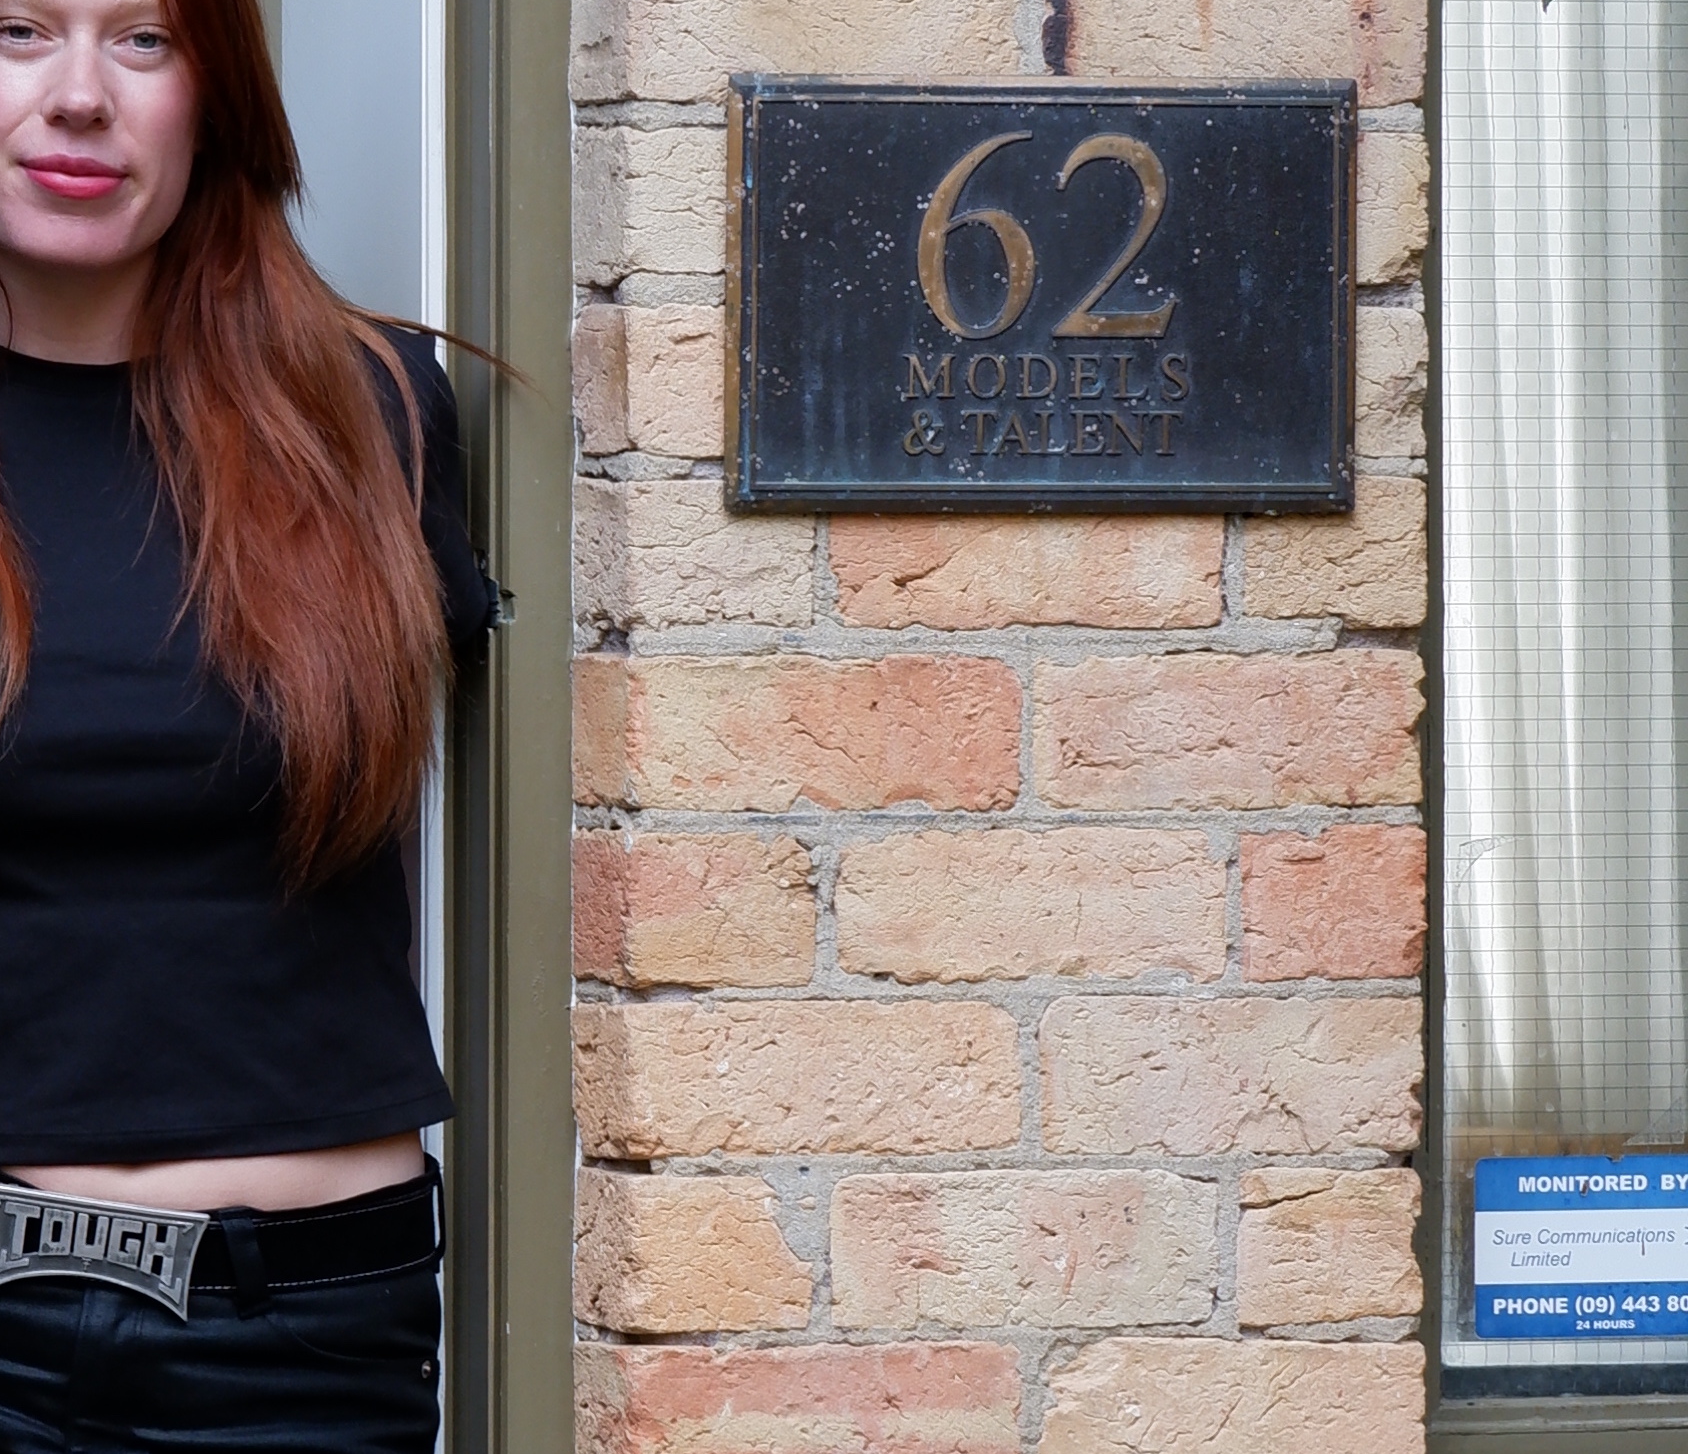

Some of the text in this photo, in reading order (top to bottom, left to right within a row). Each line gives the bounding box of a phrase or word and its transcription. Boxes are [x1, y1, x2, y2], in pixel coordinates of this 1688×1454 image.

[917, 129, 1178, 340] 62
[902, 353, 1191, 400] MODELS
[902, 410, 1183, 456] & TALENT
[1518, 1173, 1688, 1193] MONITORED BY
[3, 1201, 179, 1287] TOUGH
[1492, 1227, 1676, 1246] Sure Communications
[1511, 1251, 1572, 1268] Limited
[1493, 1297, 1569, 1315] PHONE
[1575, 1295, 1616, 1316] (09)
[1621, 1296, 1661, 1313] 443
[1576, 1319, 1636, 1330] 24 HOURS
